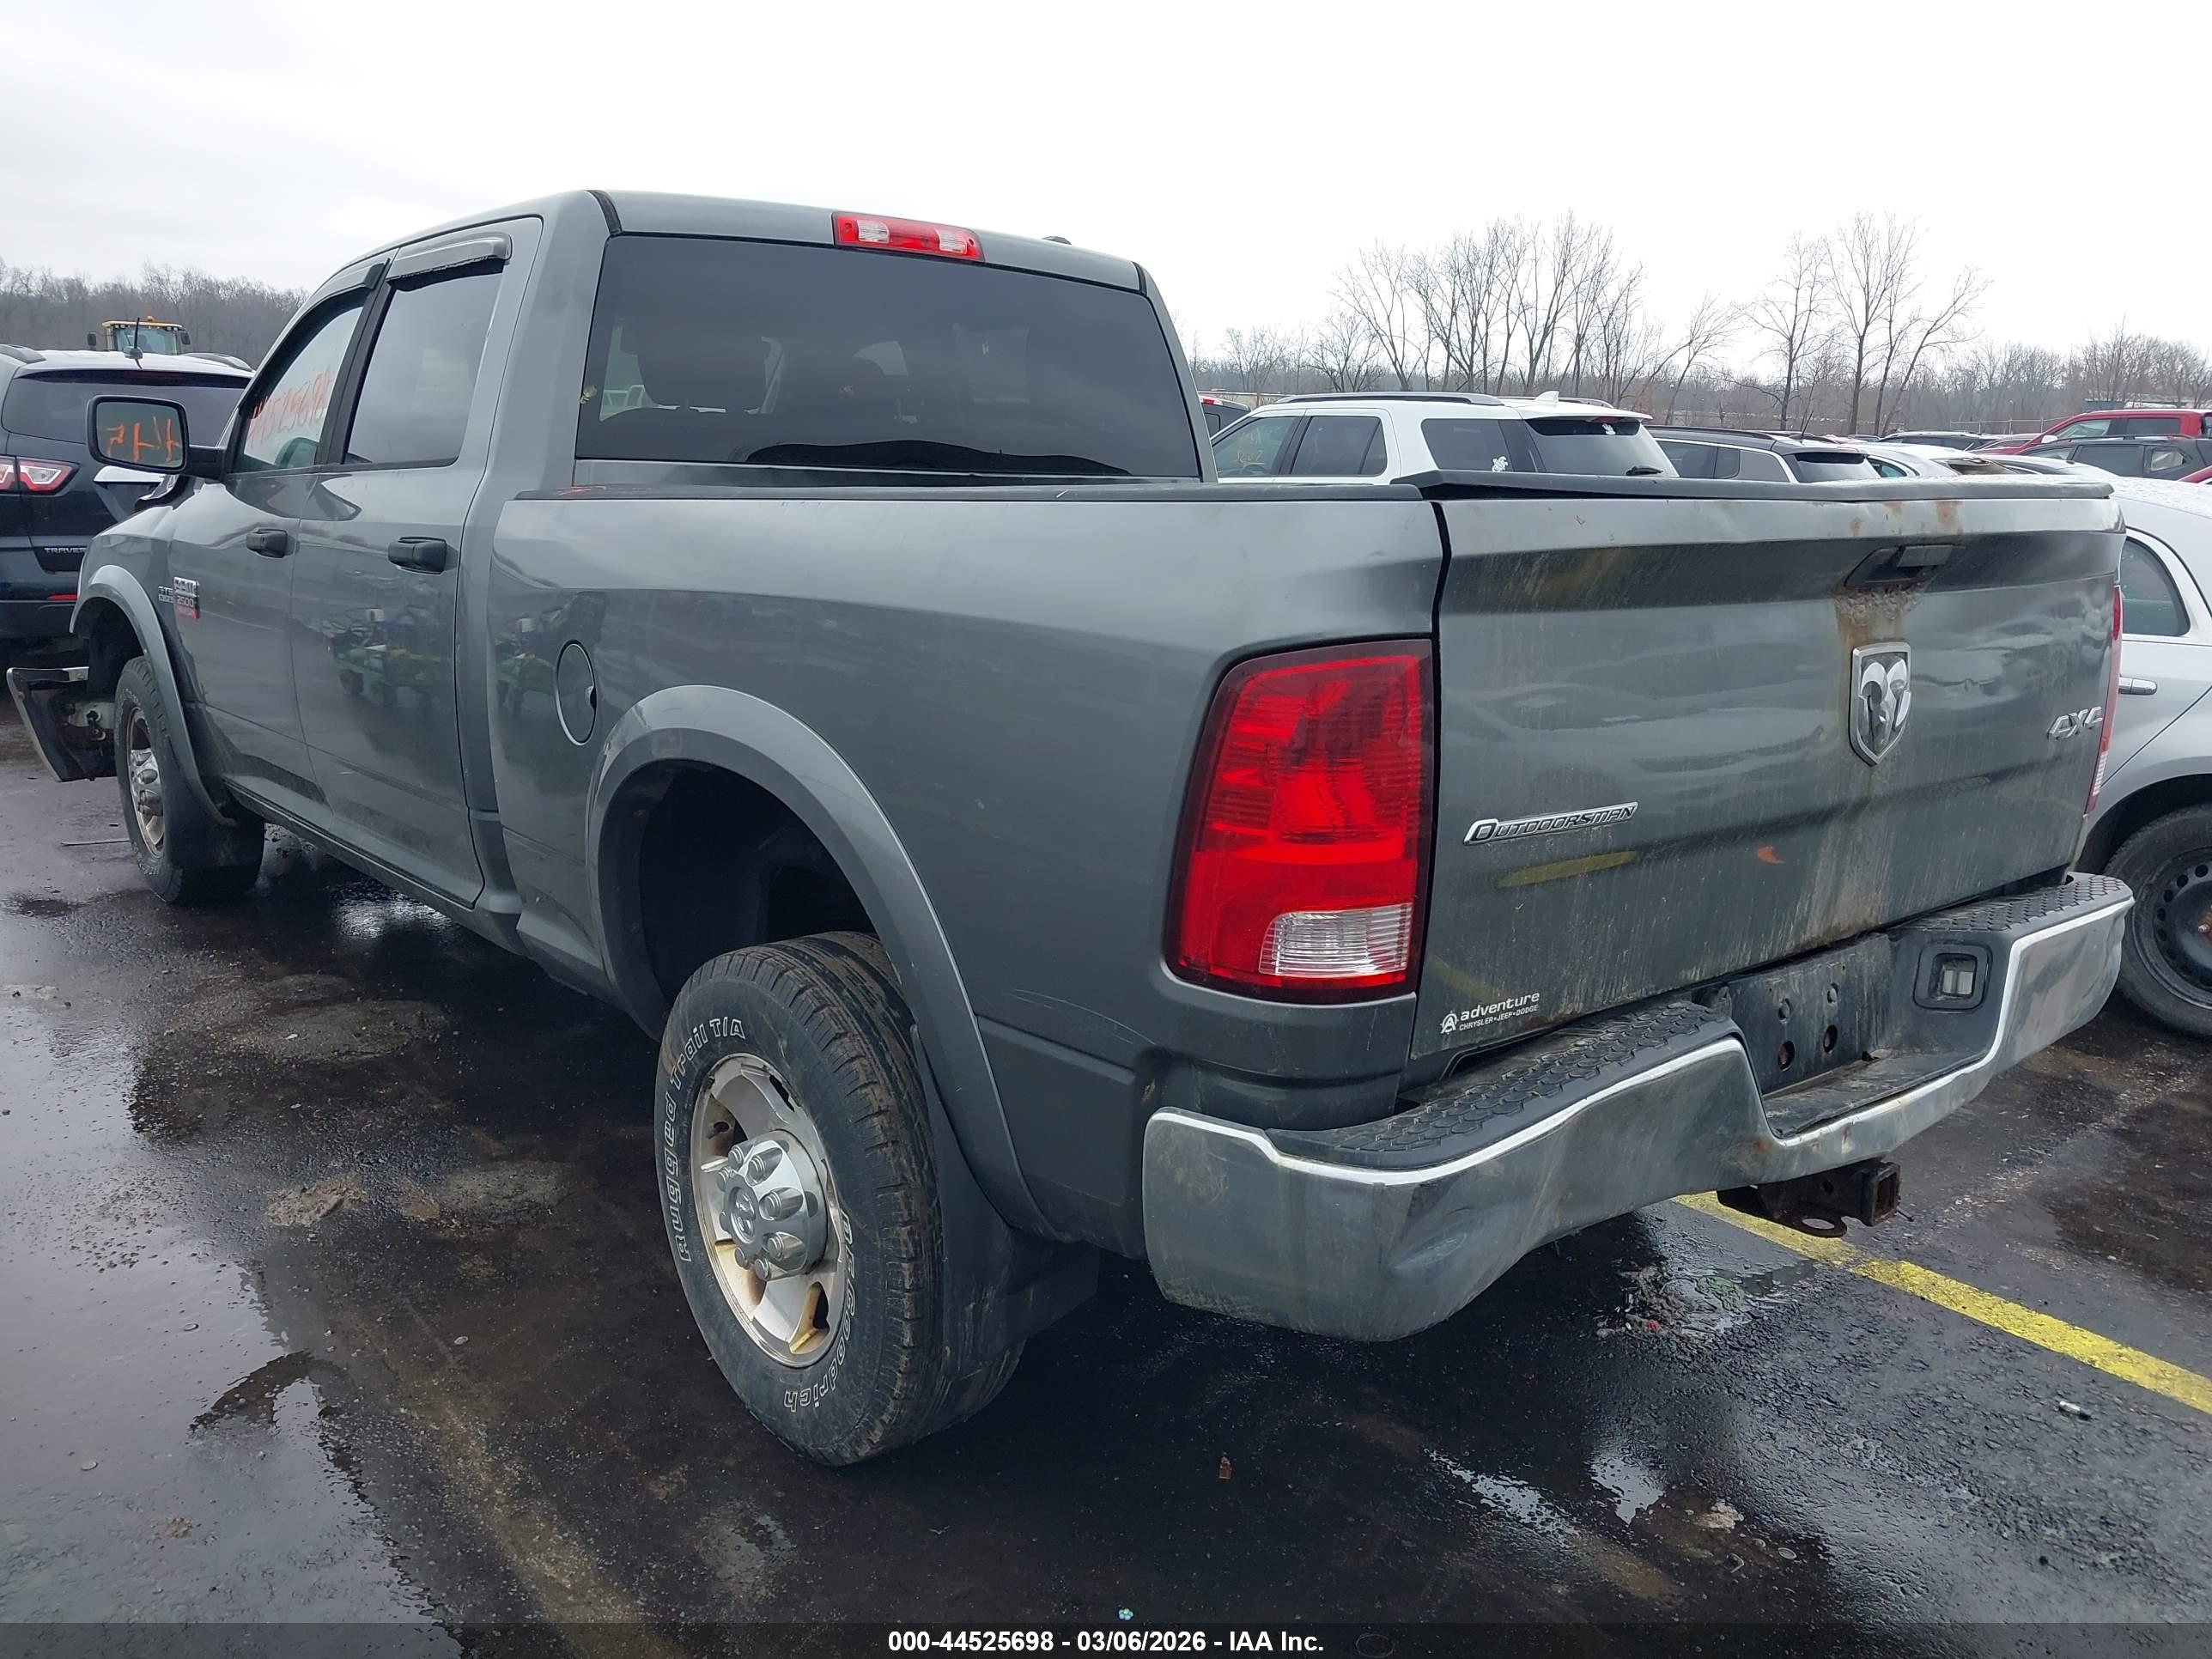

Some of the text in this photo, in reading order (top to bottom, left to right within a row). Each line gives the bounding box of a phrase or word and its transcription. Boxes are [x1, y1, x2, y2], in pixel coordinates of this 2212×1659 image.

[670, 1023, 708, 1091] Trail
[1460, 993, 1540, 1022] adventure
[664, 1091, 692, 1262] Rugged
[783, 1208, 856, 1413] BFGoodrich
